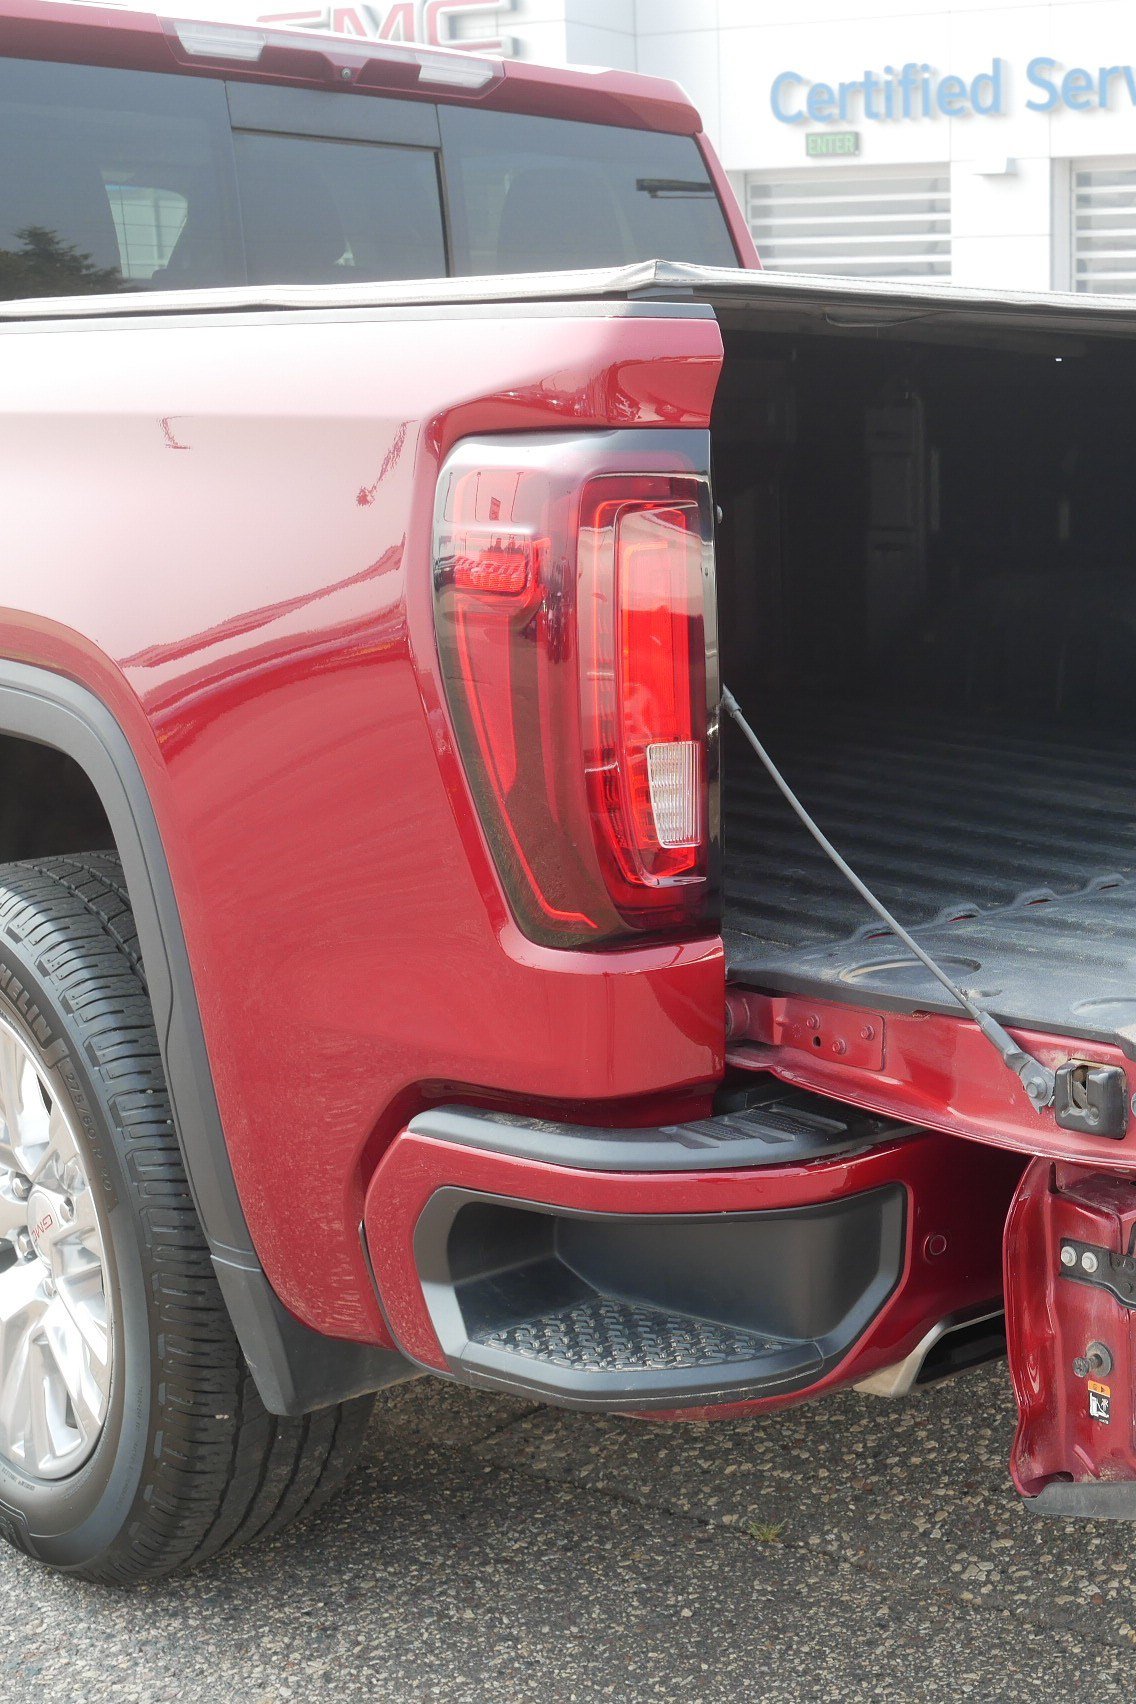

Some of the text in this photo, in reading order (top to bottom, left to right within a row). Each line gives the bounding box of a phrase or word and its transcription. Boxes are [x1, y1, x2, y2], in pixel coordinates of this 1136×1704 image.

[257, 0, 504, 52] MC
[770, 59, 1002, 123] Certified
[808, 135, 854, 154] ENTER
[31, 1214, 54, 1243] GMC
